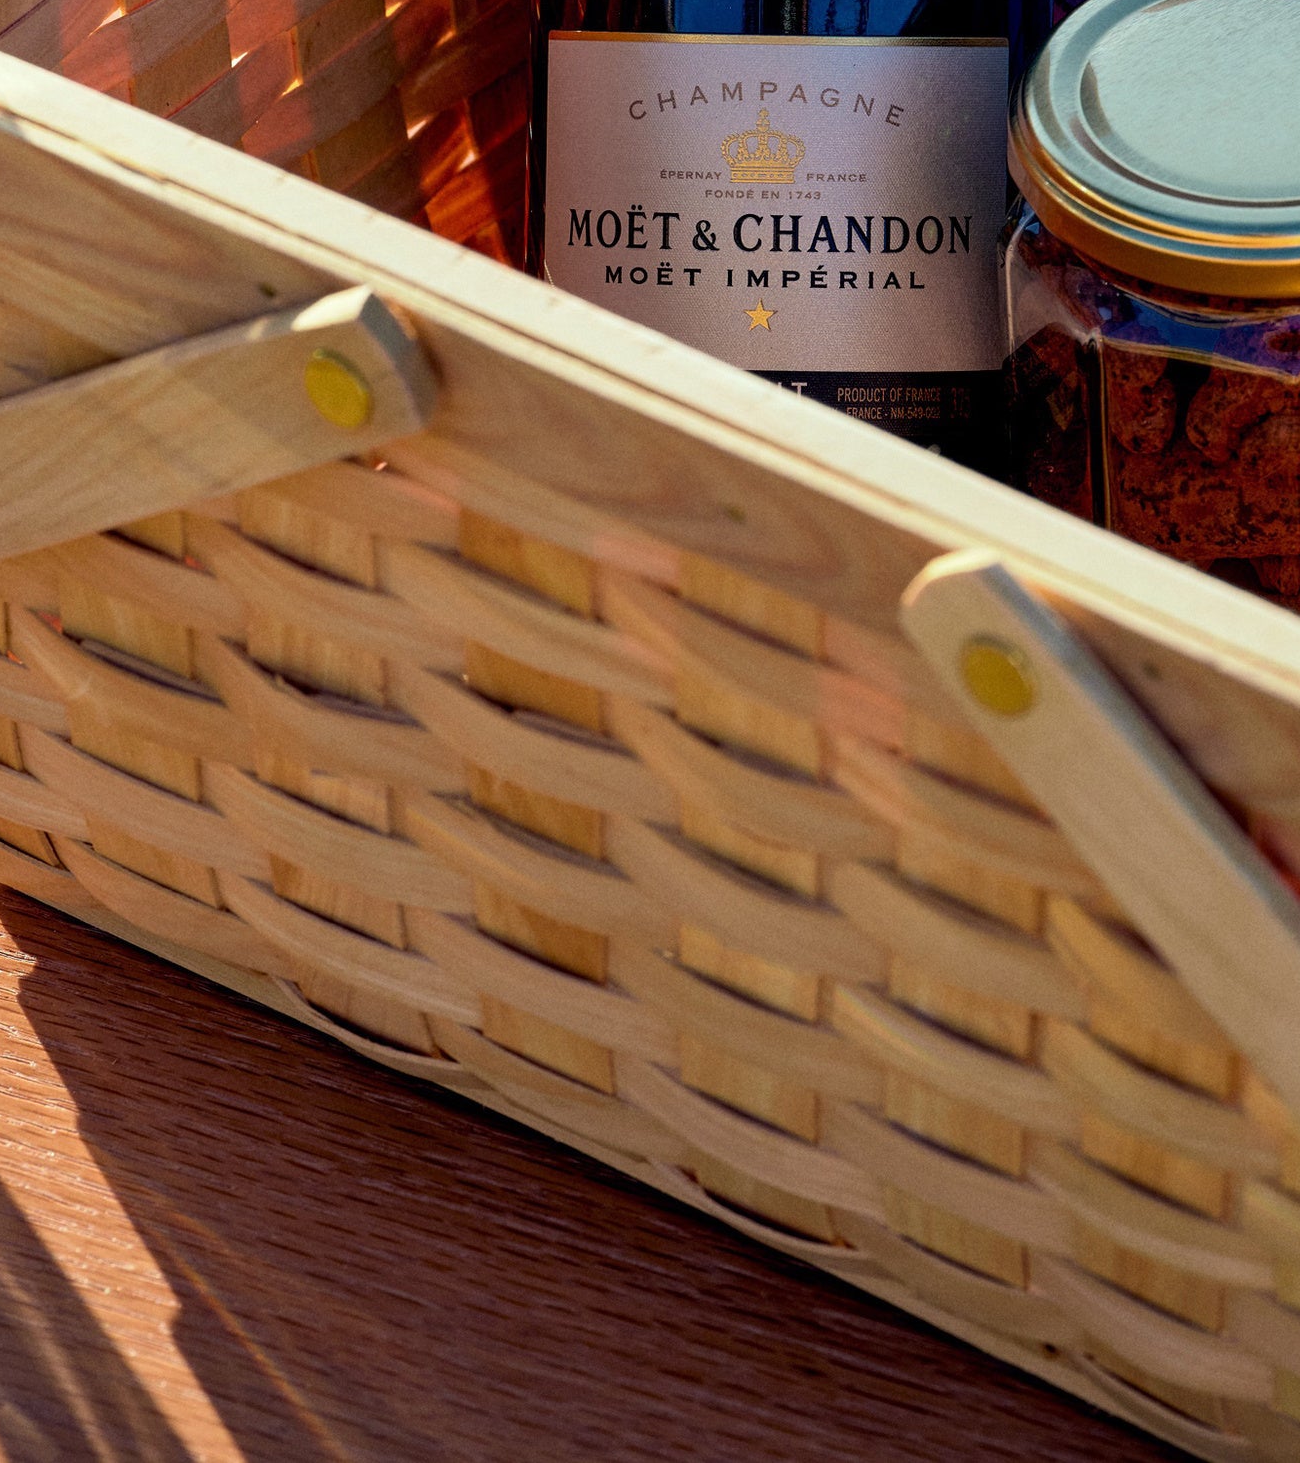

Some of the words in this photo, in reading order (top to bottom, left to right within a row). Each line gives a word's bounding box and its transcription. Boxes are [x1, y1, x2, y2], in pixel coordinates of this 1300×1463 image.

[628, 81, 905, 128] CHAMPAGNE
[660, 169, 722, 181] ÉPERNAY
[806, 173, 868, 183] FRANCE
[705, 188, 754, 199] FONDÉ
[761, 190, 780, 199] EN
[788, 191, 821, 200] 1743
[567, 205, 681, 250] MOËT
[692, 218, 720, 252] &
[733, 213, 972, 254] CHANDON
[605, 261, 703, 287] MOËT
[727, 264, 926, 289] IMPÉRIAL
[837, 388, 886, 402] PRODUCT
[889, 388, 902, 402] OF
[905, 388, 941, 401] FRANCE
[846, 407, 882, 420] FRANCE
